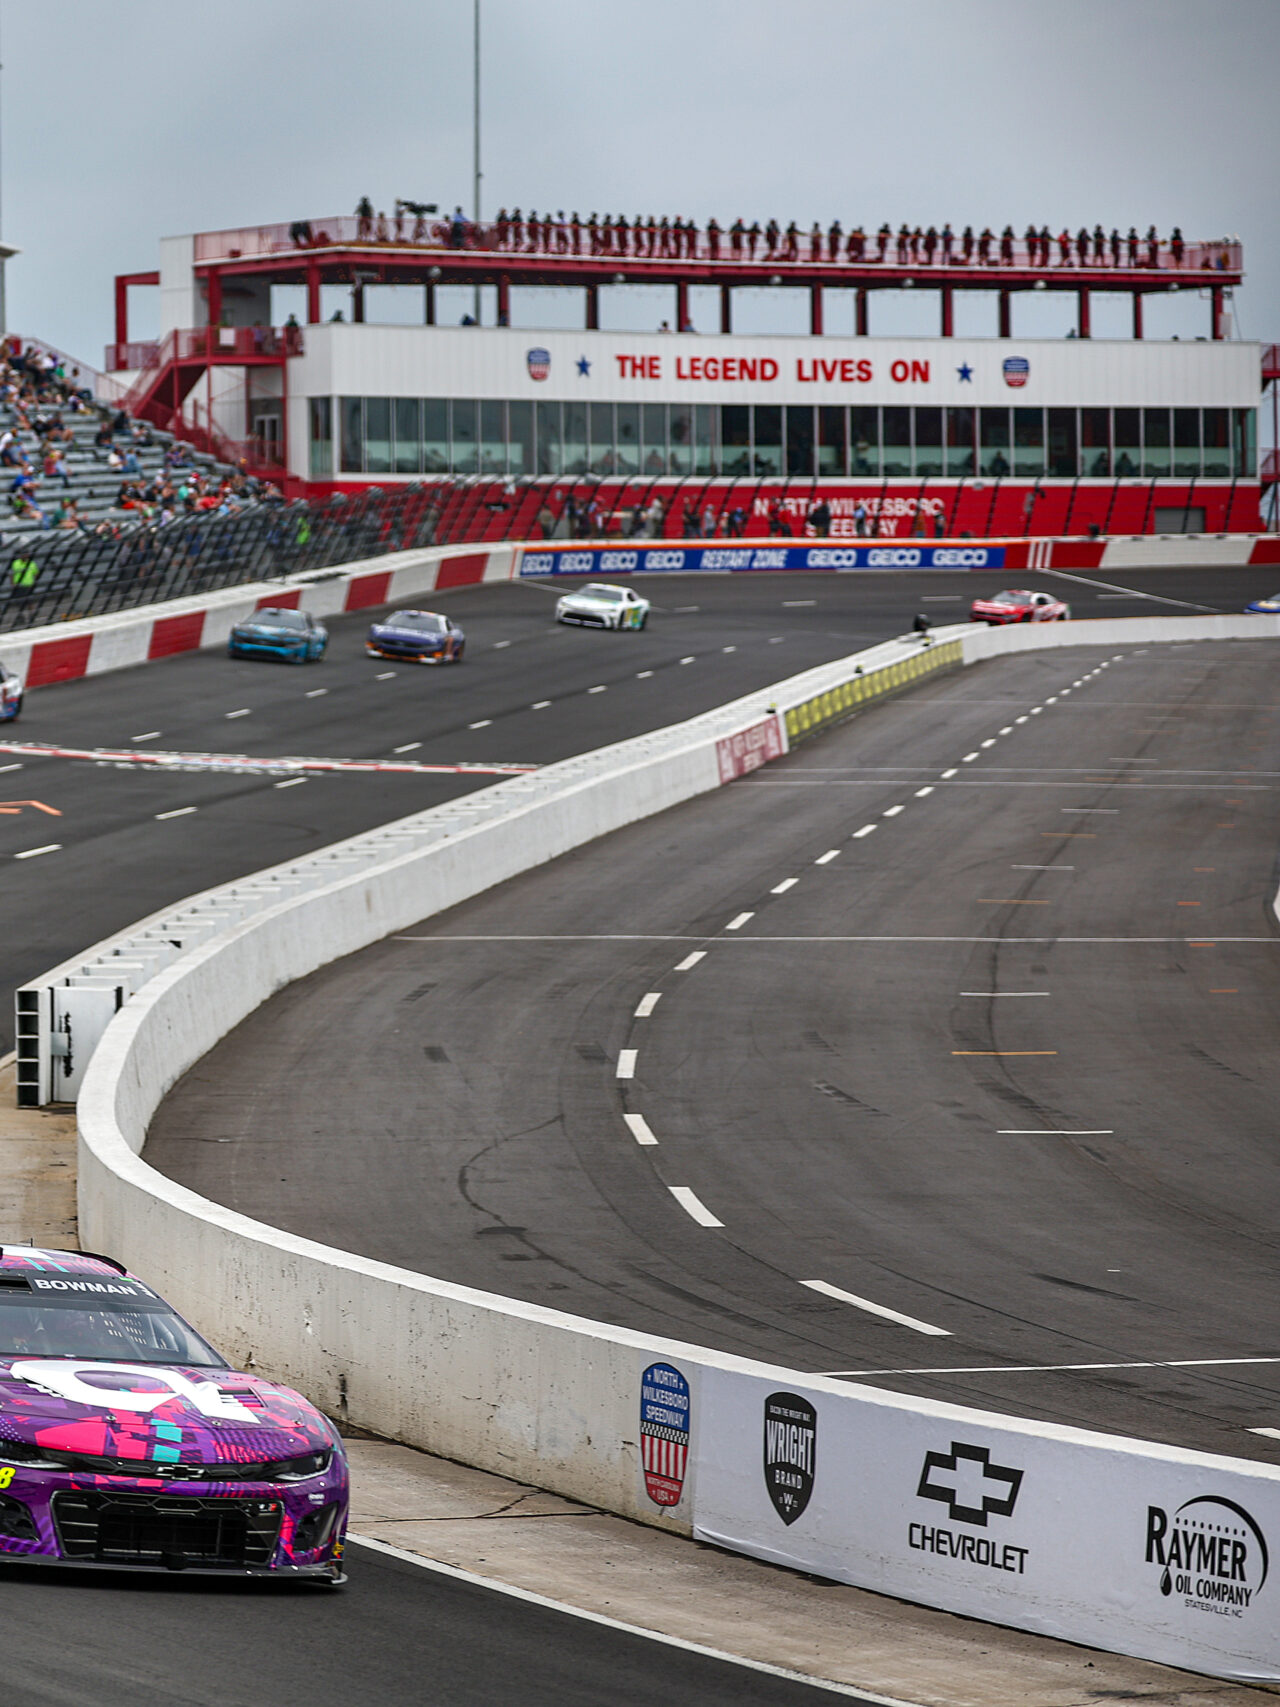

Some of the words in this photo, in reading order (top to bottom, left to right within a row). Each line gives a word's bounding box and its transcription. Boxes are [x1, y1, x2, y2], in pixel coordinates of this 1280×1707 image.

[616, 355, 660, 379] THE
[676, 357, 778, 382] LEGEND
[797, 359, 873, 383] LIVES
[891, 360, 930, 383] ON
[754, 498, 822, 517] NRT
[522, 554, 554, 574] GEICO
[559, 552, 594, 572] GEICO
[600, 552, 637, 571] GEICO
[645, 551, 685, 570] GEICO
[700, 550, 752, 570] RESTART
[752, 549, 788, 568] ZONE
[807, 549, 857, 567] GEICO
[868, 549, 921, 567] GEICO
[932, 549, 988, 567] GEICO
[34, 1278, 138, 1297] BOWMAN
[653, 1368, 679, 1389] NORTH
[642, 1385, 689, 1411] WILKESBORO
[645, 1405, 685, 1428] SPEEDWAY
[766, 1419, 814, 1476] WRIGHT
[775, 1469, 803, 1489] BRAND
[656, 1488, 669, 1502] USA
[908, 1522, 1029, 1574] CHEVROLET
[1145, 1505, 1247, 1582] RAYMER
[1176, 1574, 1193, 1595] OIL
[1196, 1578, 1253, 1607] COMPANY
[1232, 1609, 1243, 1618] NC
